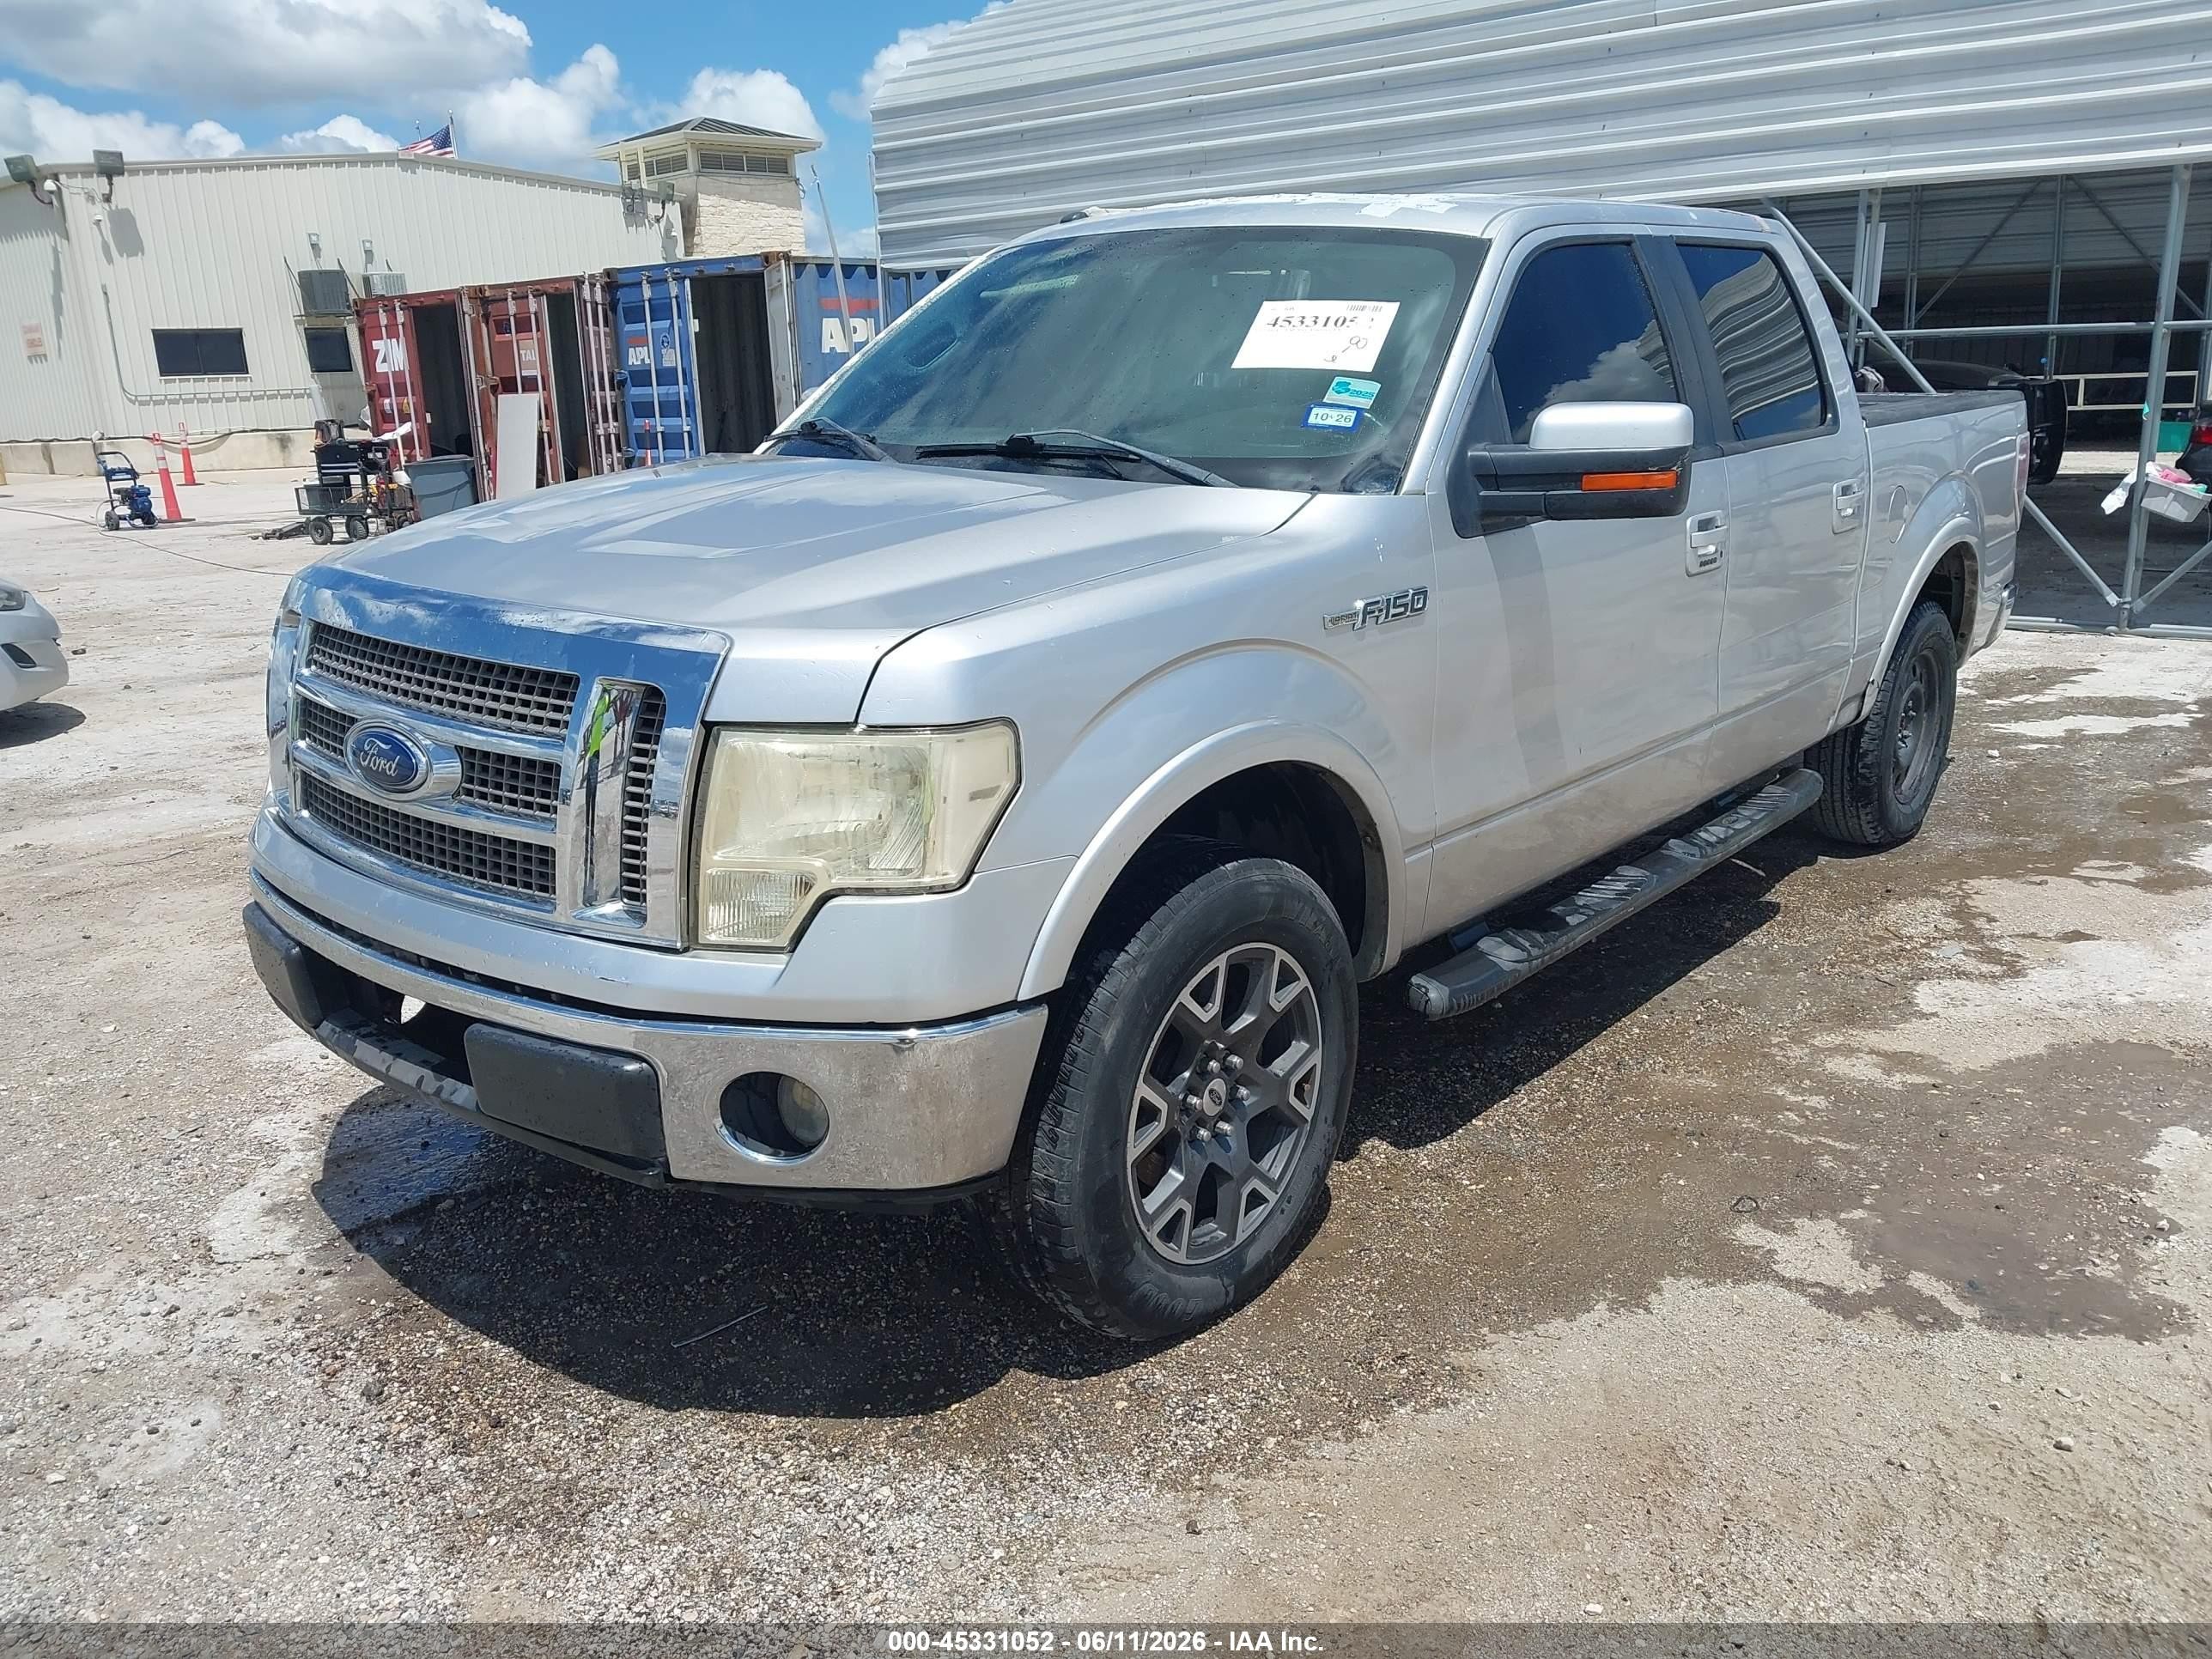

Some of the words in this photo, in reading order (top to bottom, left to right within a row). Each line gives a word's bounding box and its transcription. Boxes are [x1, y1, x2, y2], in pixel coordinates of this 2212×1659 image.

[372, 338, 408, 372] ZIM
[628, 346, 650, 366] APL
[1352, 586, 1430, 631] F-150
[360, 738, 401, 777] Ford
